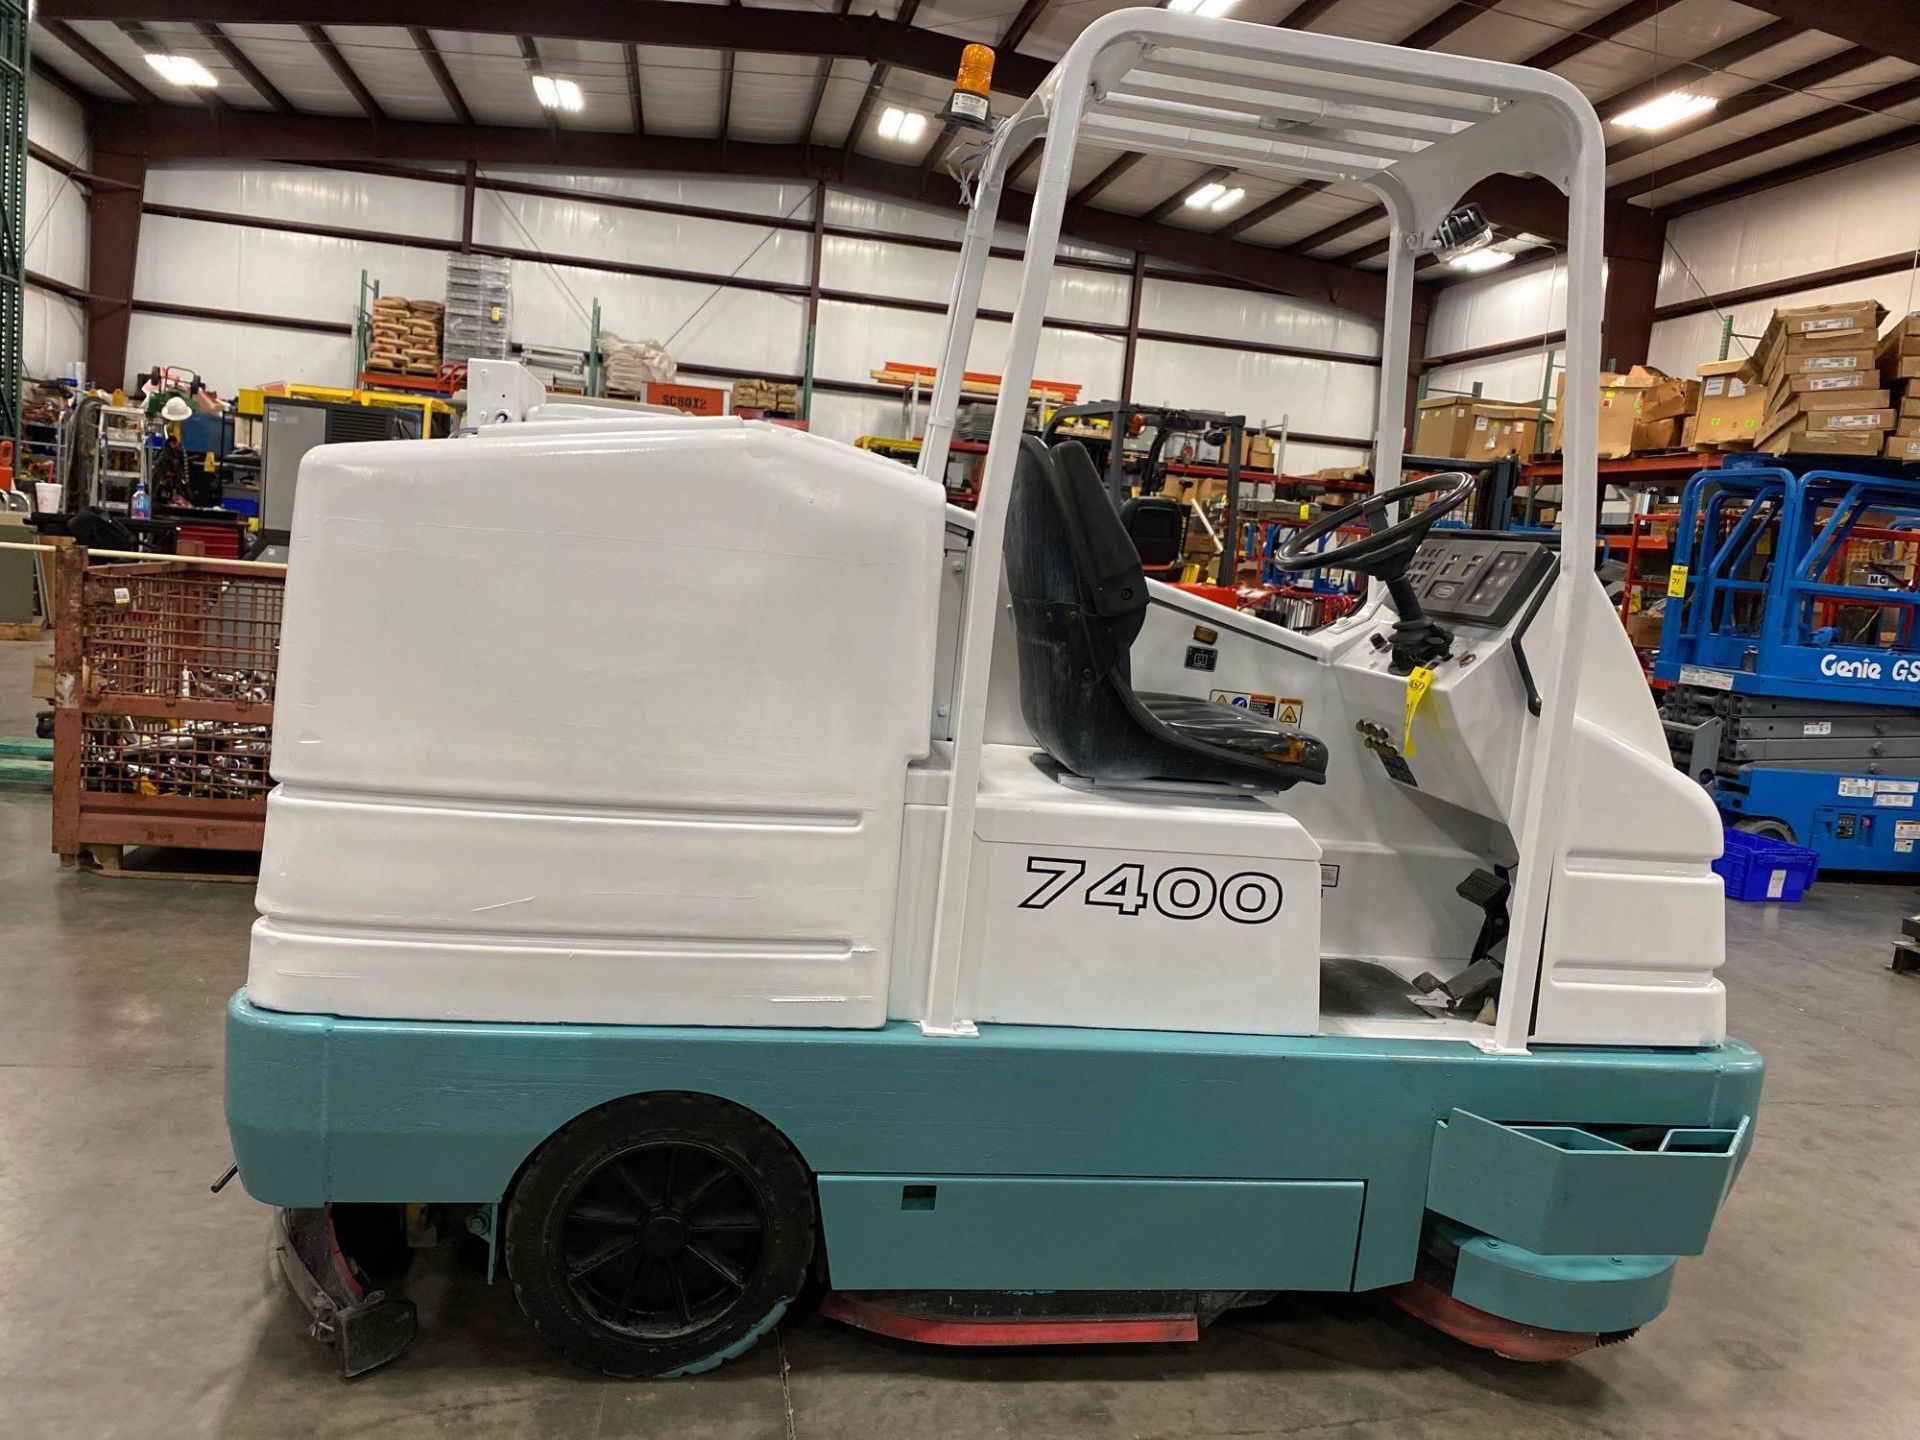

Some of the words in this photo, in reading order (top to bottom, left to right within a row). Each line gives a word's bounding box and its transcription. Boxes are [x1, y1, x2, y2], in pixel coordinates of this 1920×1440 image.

[1869, 575, 1887, 585] MC
[1820, 653, 1882, 679] Genie
[1892, 659, 1920, 682] GS
[1017, 856, 1284, 925] 7400
